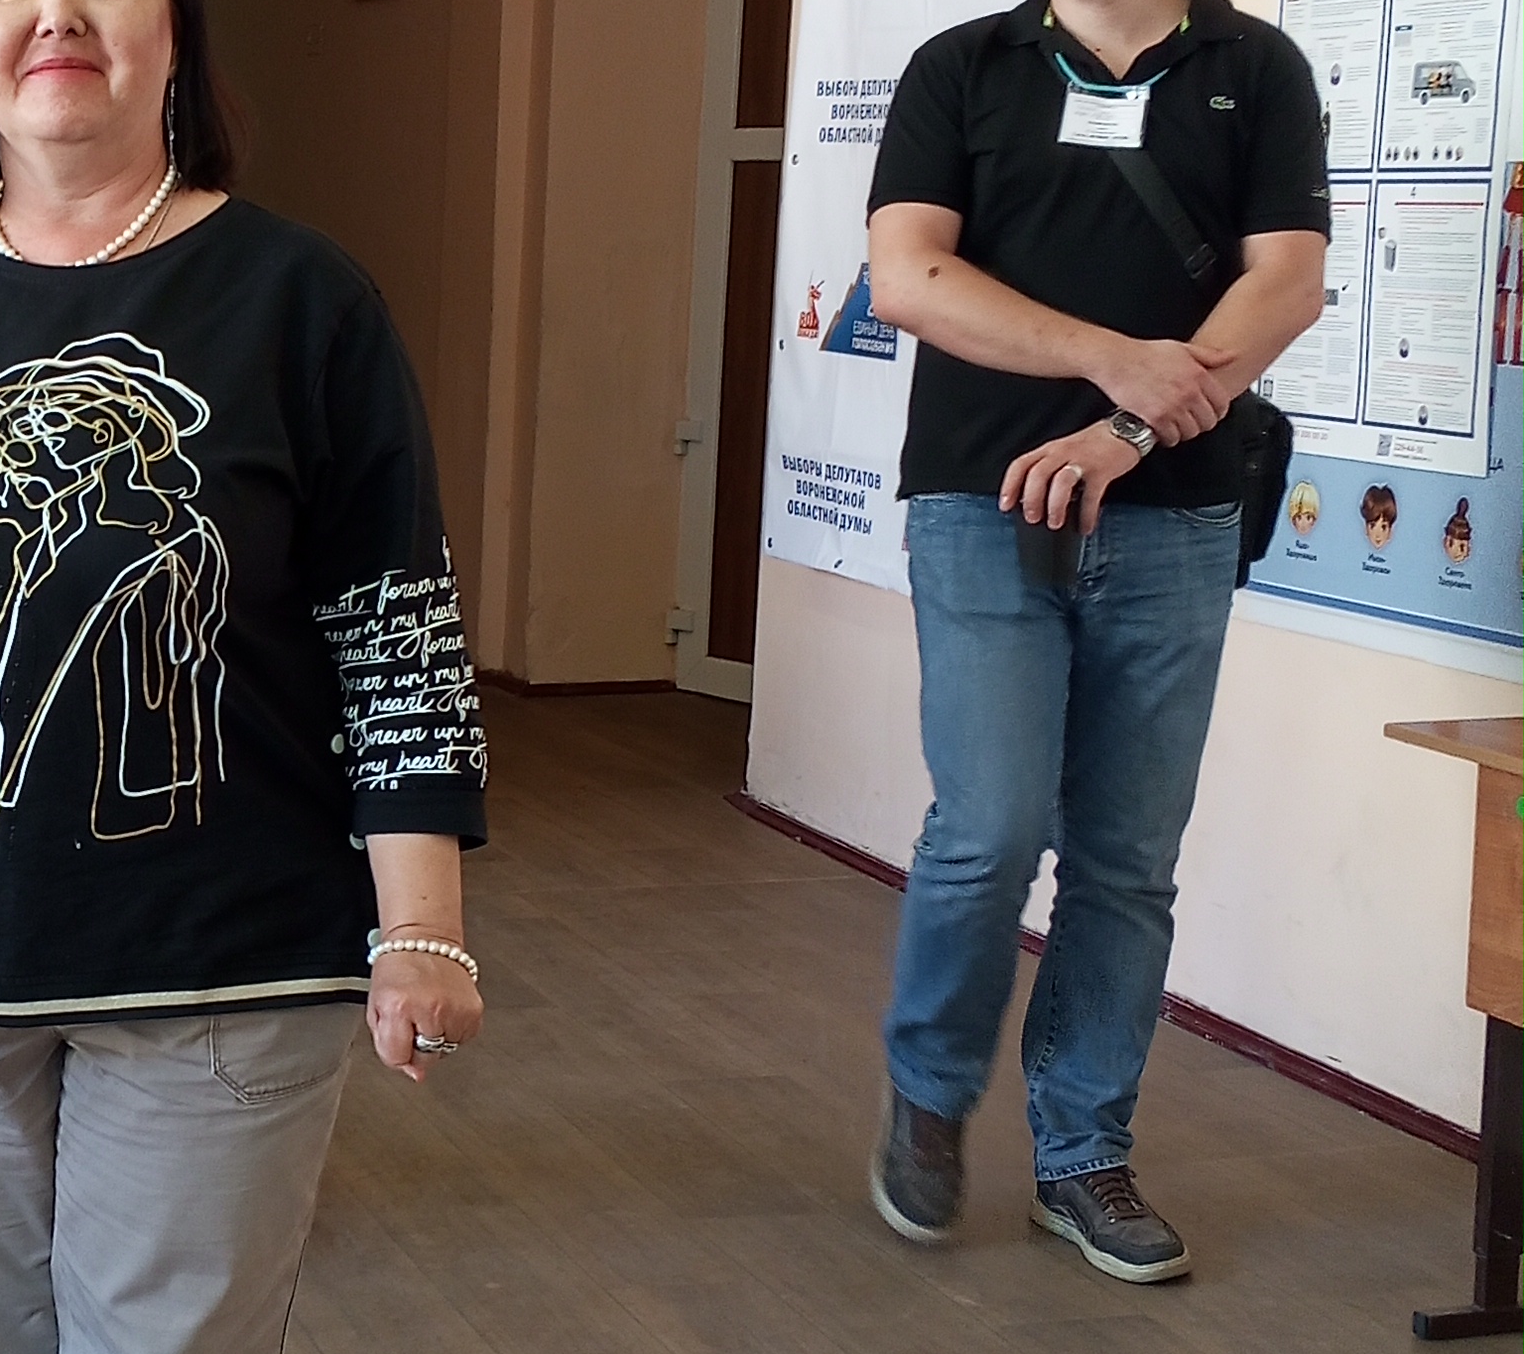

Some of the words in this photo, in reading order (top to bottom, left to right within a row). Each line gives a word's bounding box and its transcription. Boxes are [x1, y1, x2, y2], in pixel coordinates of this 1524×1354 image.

[816, 80, 859, 97] ВЫБОРЫ
[782, 454, 823, 477] ВЫБОРЫ
[824, 463, 882, 490] ДЕПУТАТОВ
[796, 479, 866, 510] ВОРОНЕЖСКОЙ
[787, 499, 839, 526] ОБЛАСТНОЙ
[838, 513, 872, 535] ДУМЫ
[368, 683, 436, 718] heart
[395, 741, 462, 775] heart
